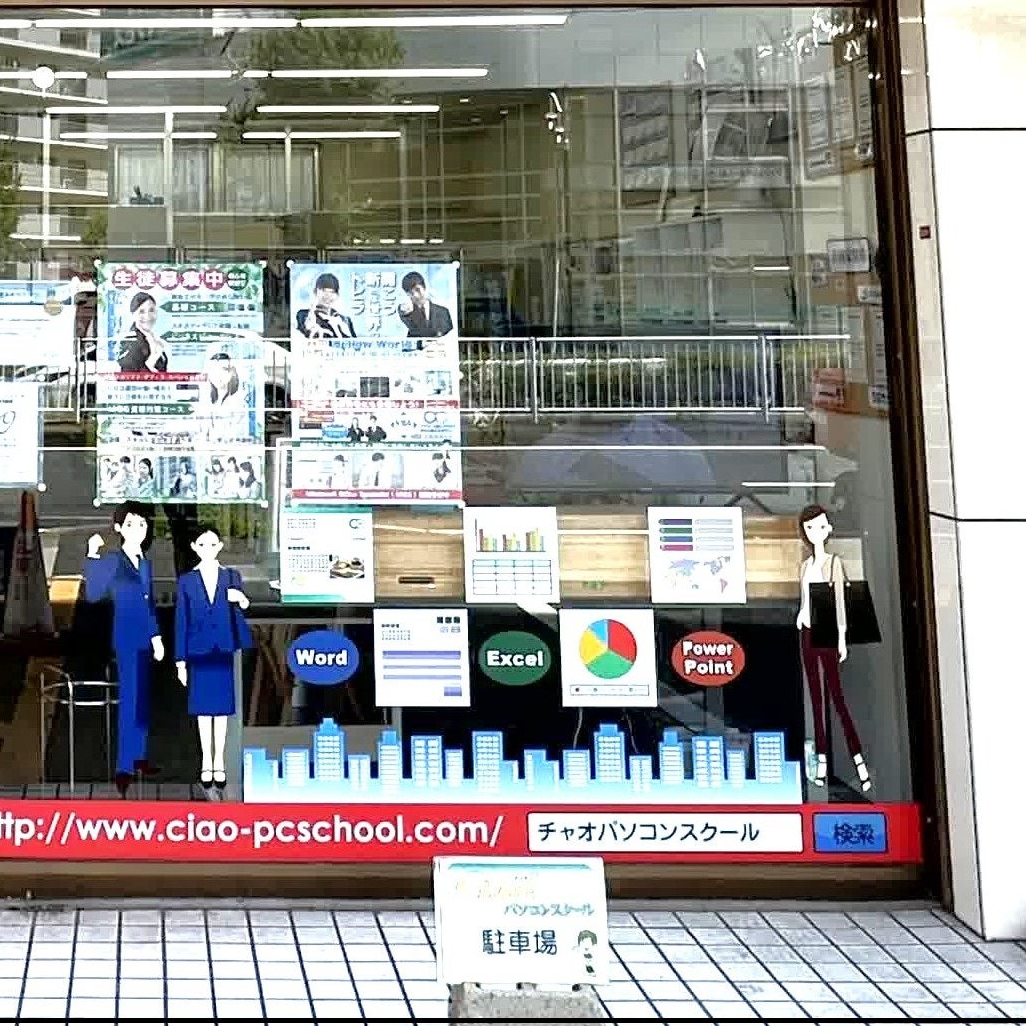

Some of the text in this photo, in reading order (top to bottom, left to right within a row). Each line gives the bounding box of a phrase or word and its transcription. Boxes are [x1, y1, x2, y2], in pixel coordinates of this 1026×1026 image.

[295, 648, 348, 667] Word
[682, 640, 734, 656] Power
[486, 649, 545, 667] Excel
[684, 660, 733, 676] Point
[537, 820, 761, 844] チャオパソコンスクール
[833, 822, 876, 847] 検索
[481, 929, 558, 956] 駐車場
